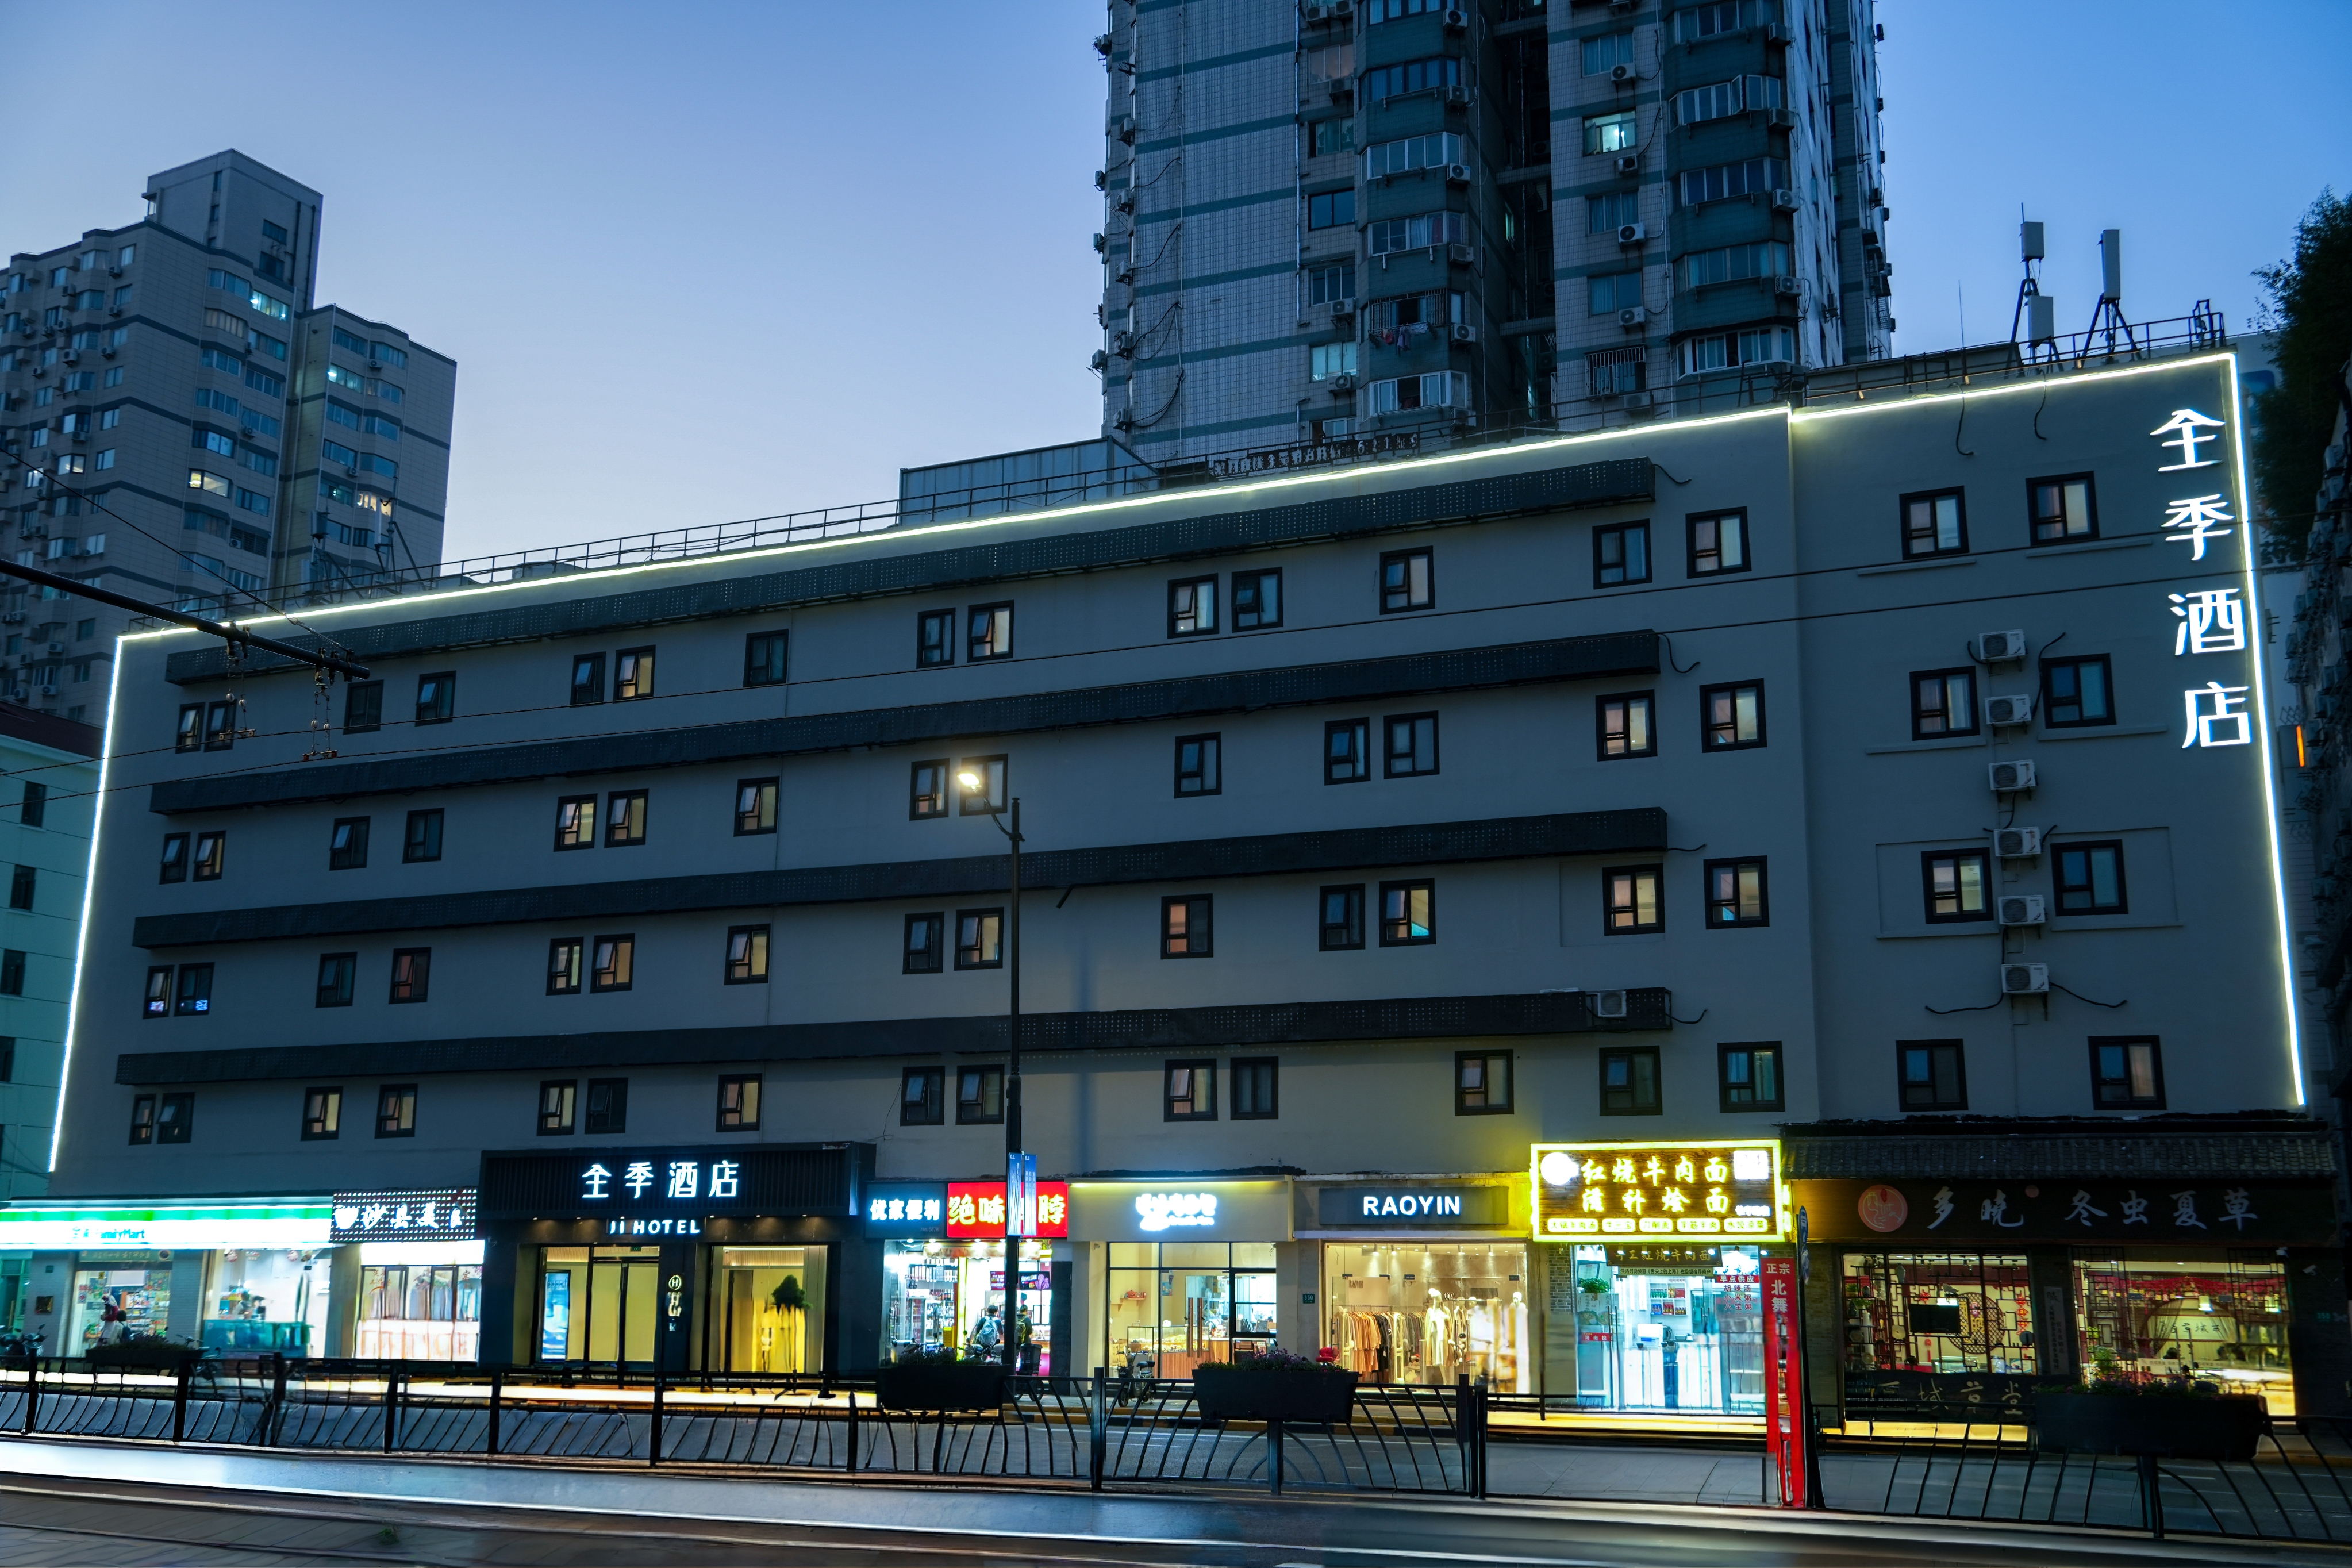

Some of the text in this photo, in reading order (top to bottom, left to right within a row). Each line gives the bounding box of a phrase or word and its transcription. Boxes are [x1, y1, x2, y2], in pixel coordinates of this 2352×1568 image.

[2150, 409, 2251, 748] 全季酒店
[582, 1160, 740, 1198] 全季酒店
[1581, 1156, 1728, 1186] 红烧牛肉面
[870, 1199, 940, 1221] 优家便利
[948, 1194, 1065, 1225] 绝味脖
[1363, 1196, 1461, 1216] RAOYIN
[2064, 1187, 2258, 1231] 冬虫夏草
[610, 1219, 700, 1234] JI HOTEL
[1766, 1263, 1790, 1274] 正宗
[1724, 1294, 1752, 1302] 小米粥
[1724, 1303, 1753, 1311] 八宝粥
[1771, 1279, 1788, 1324] 北舞
